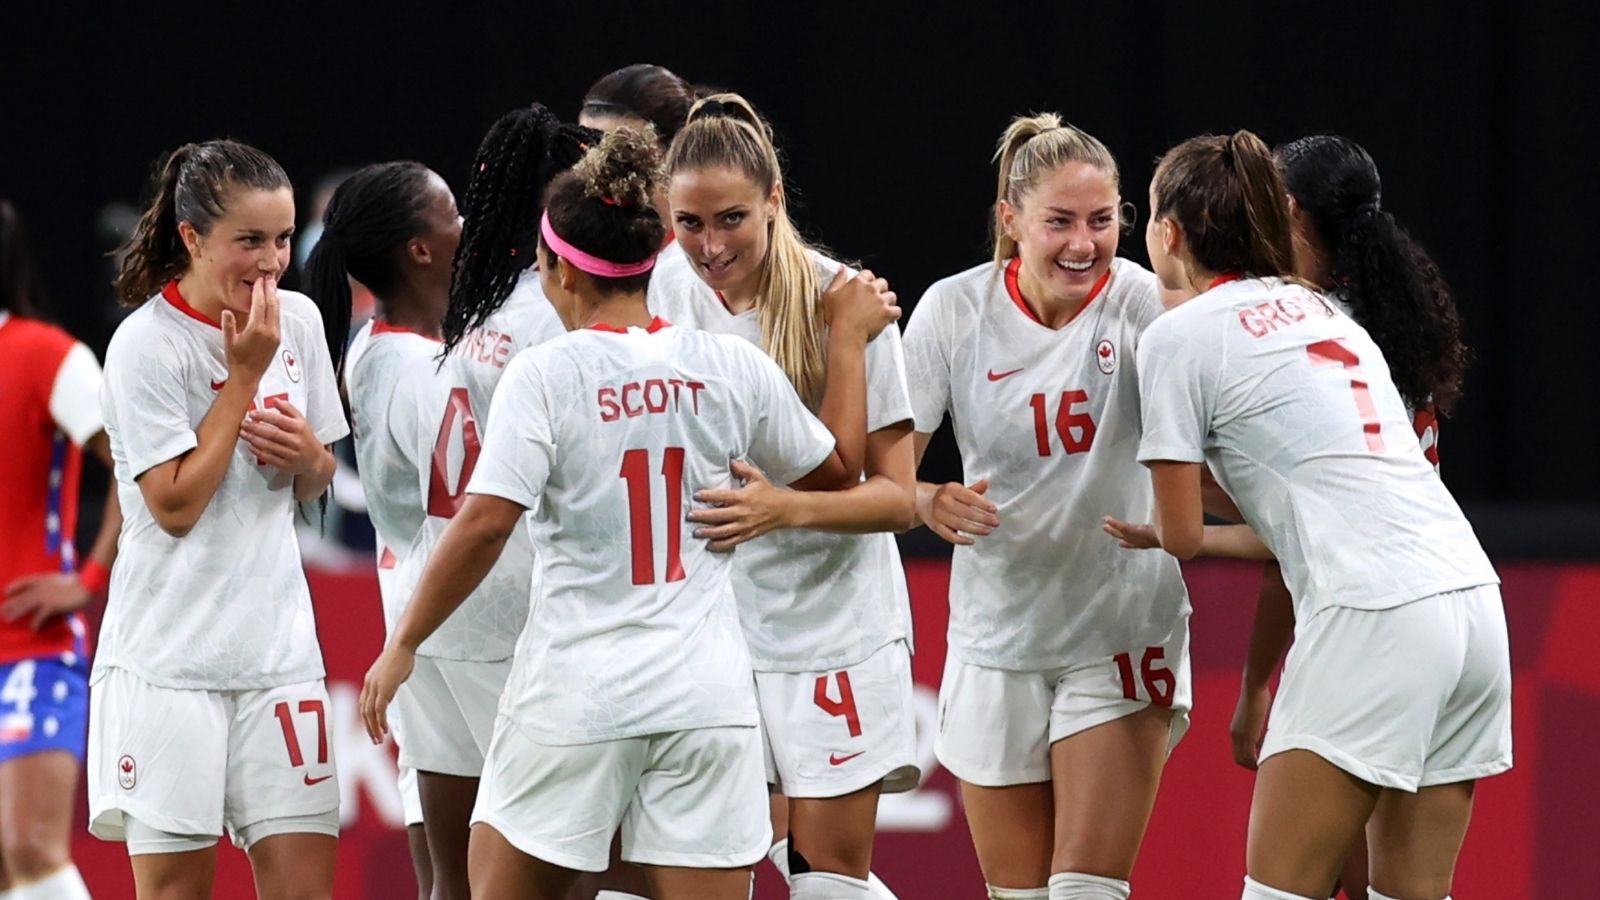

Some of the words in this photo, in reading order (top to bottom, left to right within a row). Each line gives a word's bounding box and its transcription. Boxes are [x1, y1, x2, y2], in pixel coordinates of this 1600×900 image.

[597, 378, 706, 423] SCOTT
[1029, 389, 1097, 457] 16
[619, 446, 687, 586] 11
[813, 670, 862, 738] 4
[1112, 646, 1176, 708] 16
[274, 700, 328, 768] 17
